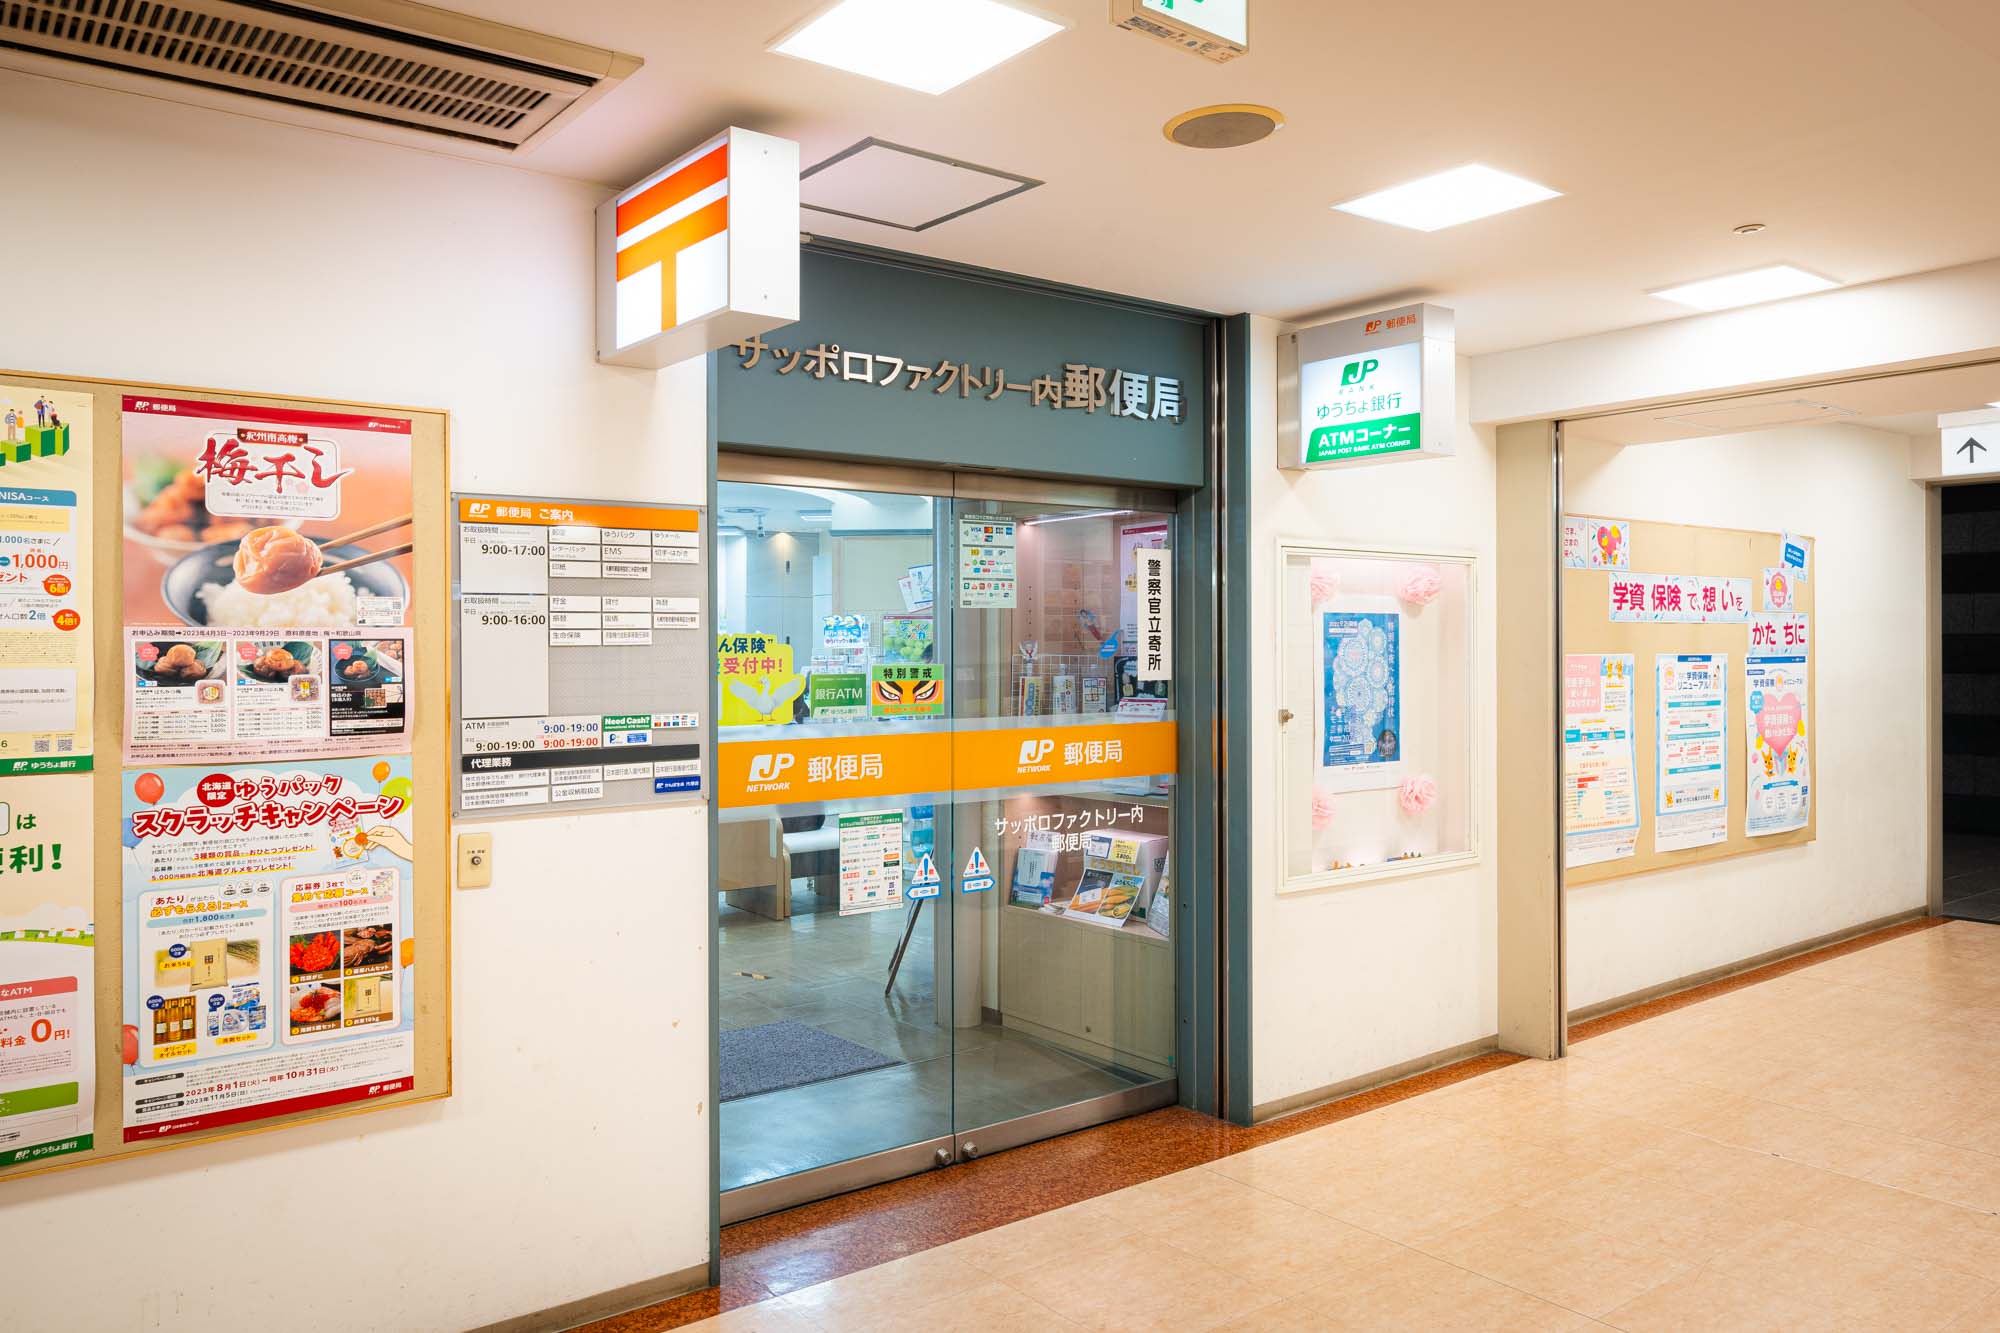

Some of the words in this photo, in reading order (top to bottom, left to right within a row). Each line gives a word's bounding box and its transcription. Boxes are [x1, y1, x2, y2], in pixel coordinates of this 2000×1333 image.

[1386, 314, 1417, 330] 郵便局
[1341, 358, 1379, 387] JP
[152, 403, 177, 412] 郵便局
[1316, 392, 1402, 420] ゆうちょ銀行
[1318, 423, 1411, 449] ATMコーナー
[1318, 449, 1337, 457] JAPAN
[1371, 443, 1386, 451] ATM
[196, 437, 353, 494] 梅干し
[496, 506, 532, 519] 郵便局
[539, 508, 574, 521] ご案内
[481, 543, 546, 556] 9:00-17:00
[604, 547, 622, 555] EMS
[481, 615, 546, 625] 9:00-16:00
[1147, 559, 1162, 671] 警察官立寄所
[723, 656, 783, 675] 受付中!
[883, 667, 933, 679] 特別警戒
[815, 687, 863, 700] 銀行ATM
[464, 721, 486, 730] ATM
[605, 717, 625, 725] Need
[626, 716, 650, 725] Cash?
[543, 723, 599, 734] 9:00-19:00
[475, 739, 535, 752] 9:00-19:00
[543, 737, 599, 749] 9:00-19:00
[1018, 738, 1054, 765] JP
[1063, 739, 1123, 766] 郵便局
[470, 757, 512, 769] 代理業務
[748, 753, 795, 782] JP
[807, 753, 883, 783] 郵便局
[1017, 764, 1052, 774] NETWORK
[201, 781, 232, 791] 北海道
[233, 773, 342, 801] ゆうパック
[746, 781, 791, 793] NETWORK
[206, 792, 227, 801] 限定
[16, 814, 37, 830] は
[132, 795, 405, 838] スクラッチキャンペーン
[993, 804, 1144, 837] サッポロファクトリー内
[1051, 832, 1092, 853] 郵便局
